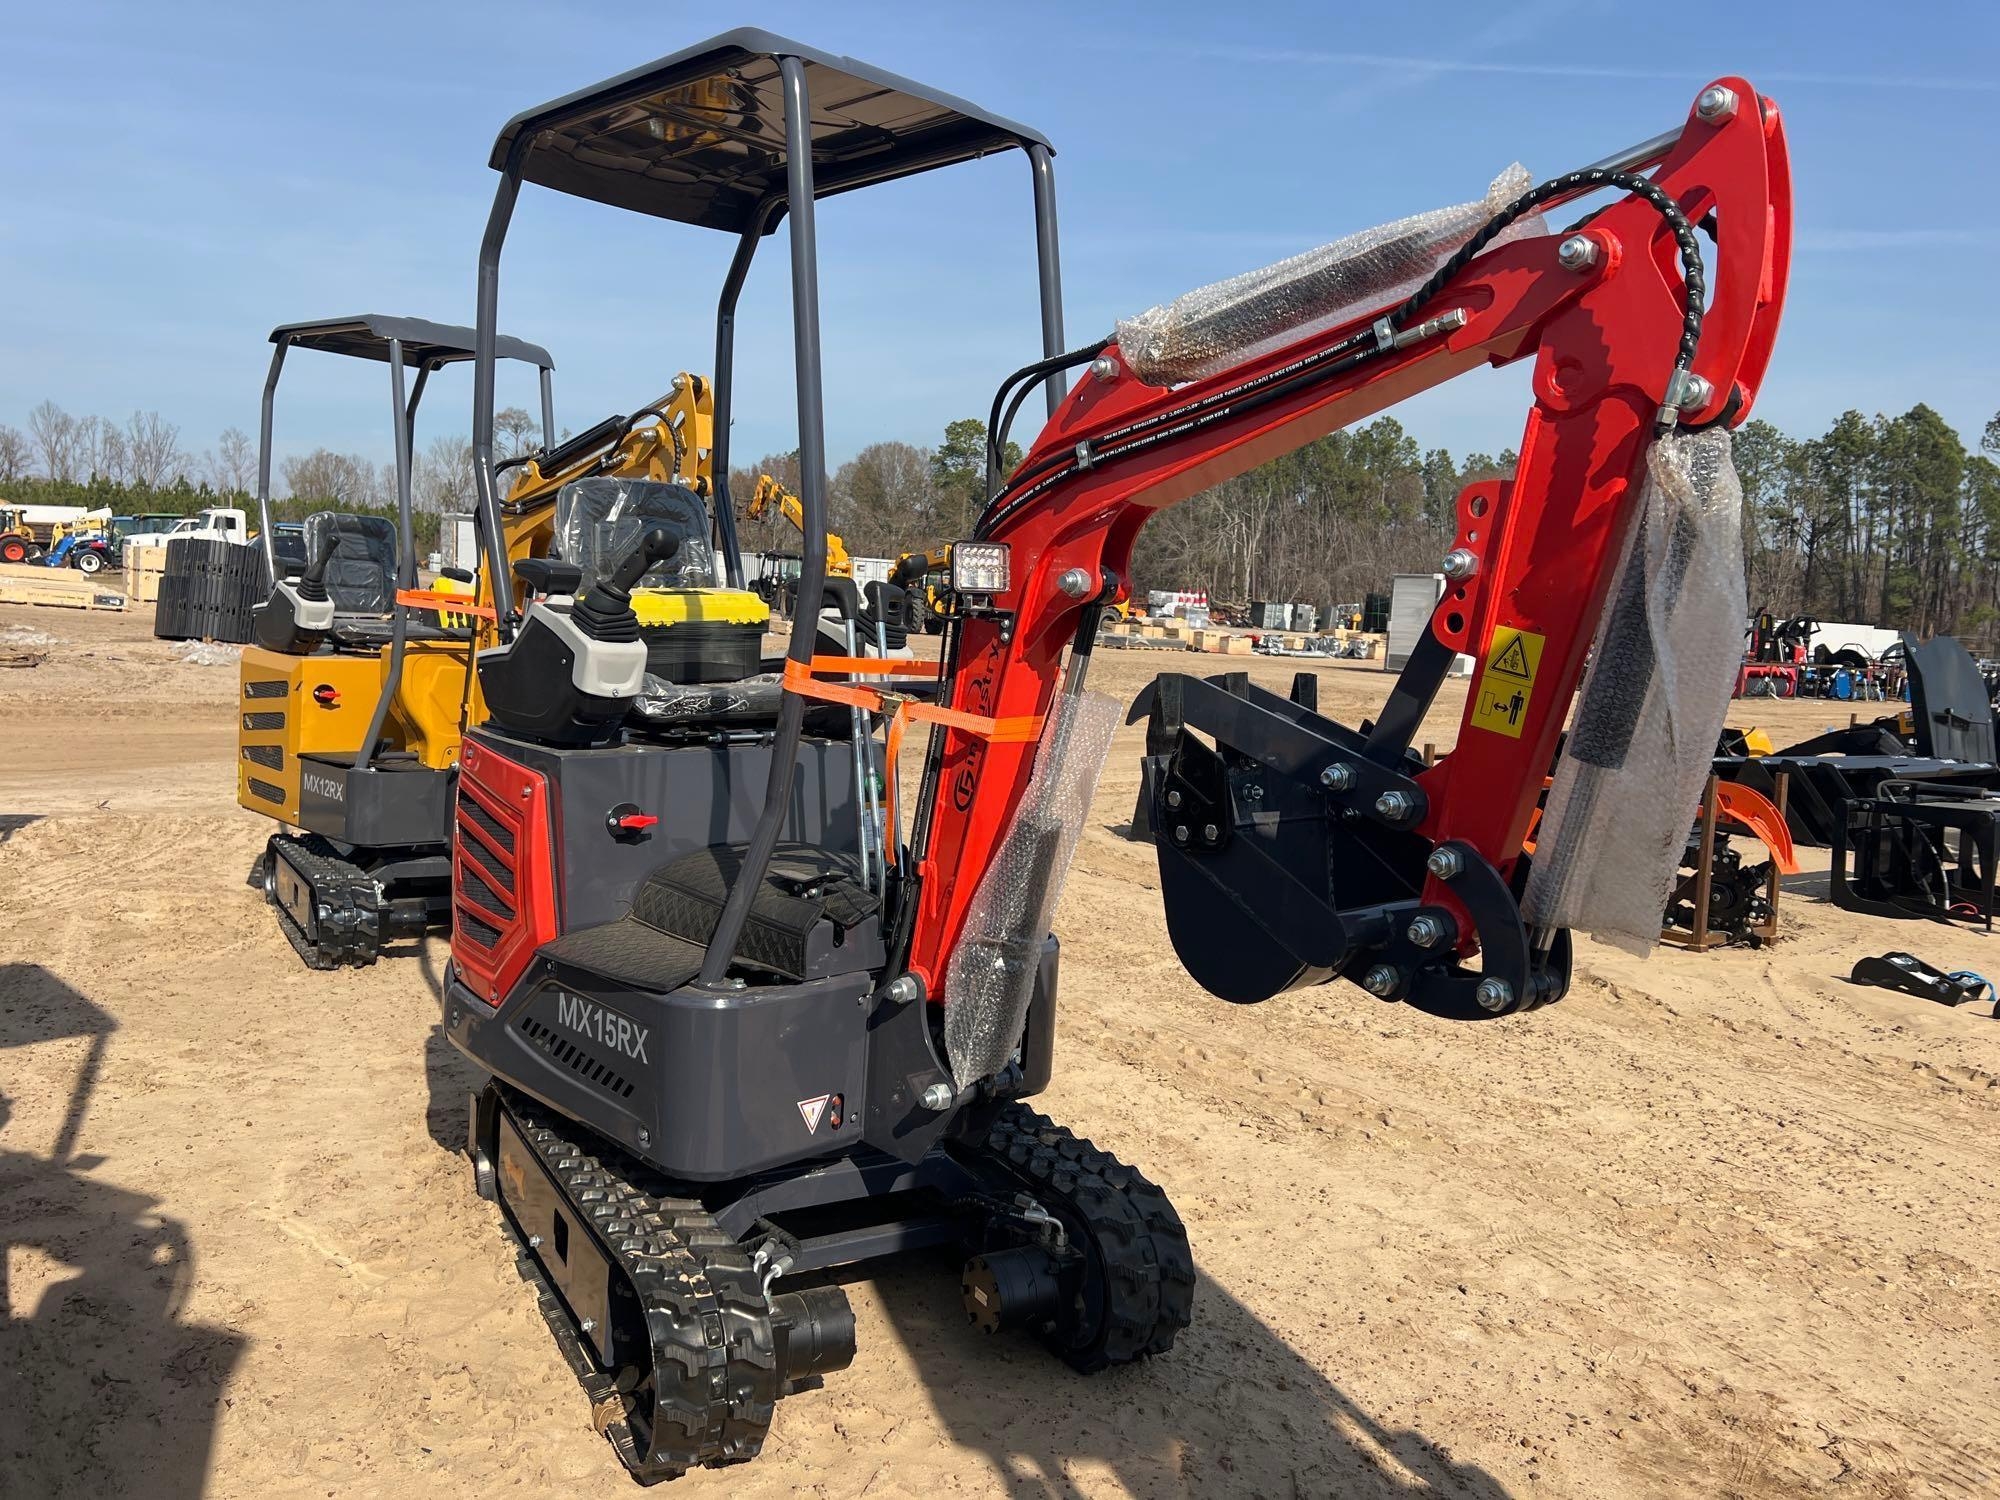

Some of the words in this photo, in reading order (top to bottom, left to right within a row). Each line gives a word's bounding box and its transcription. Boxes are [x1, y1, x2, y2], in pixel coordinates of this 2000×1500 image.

[1305, 355, 1318, 364] HOSE
[1319, 341, 1348, 357] HYDRAULIC
[303, 772, 343, 802] MX12RX
[558, 992, 648, 1065] MX15RX
